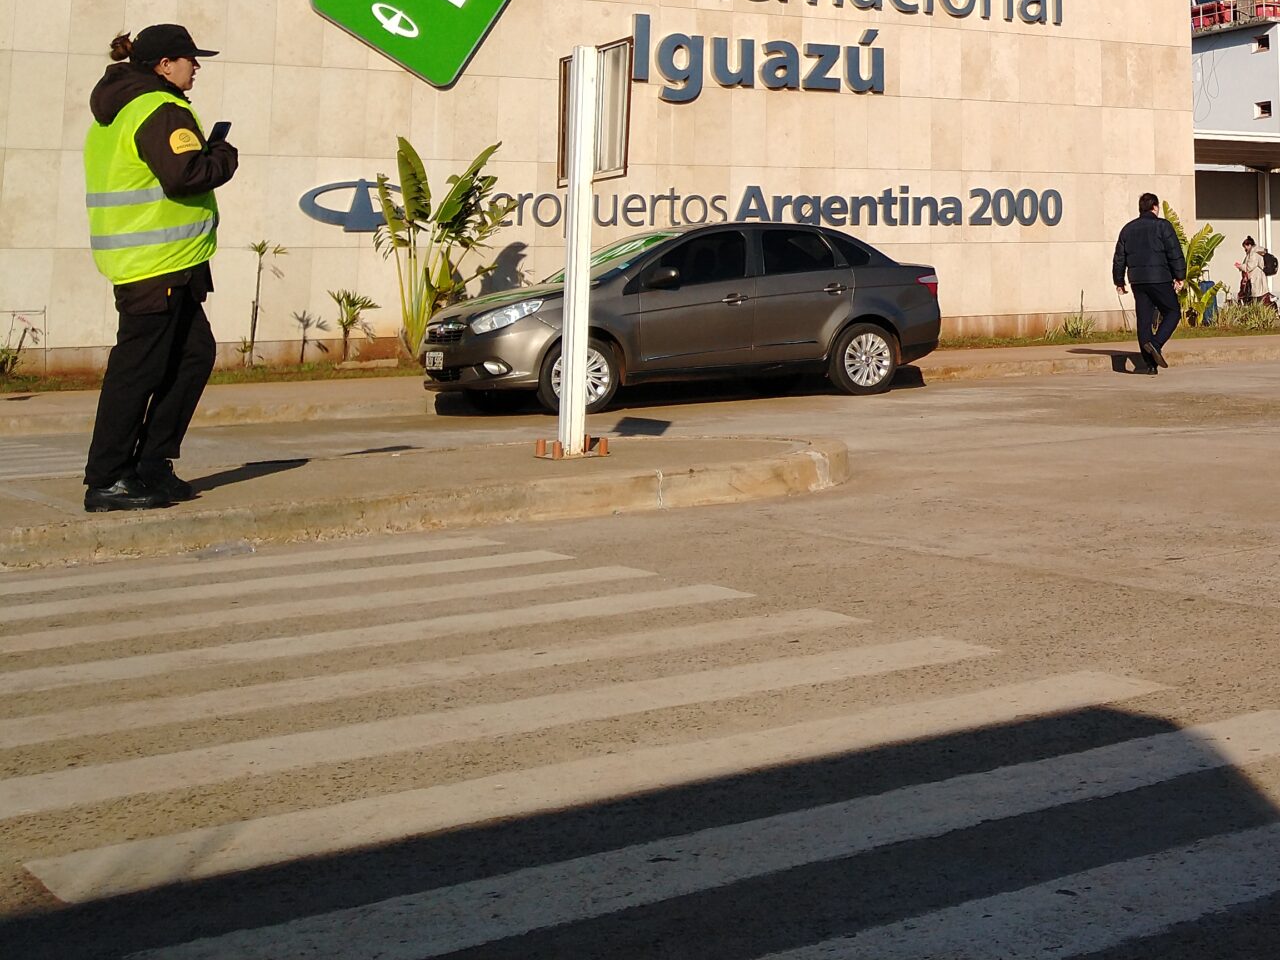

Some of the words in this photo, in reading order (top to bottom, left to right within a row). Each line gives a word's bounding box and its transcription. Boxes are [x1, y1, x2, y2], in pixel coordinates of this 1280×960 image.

[632, 13, 886, 102] Iguazú
[735, 186, 962, 226] Argentina
[969, 187, 1063, 227] 2000
